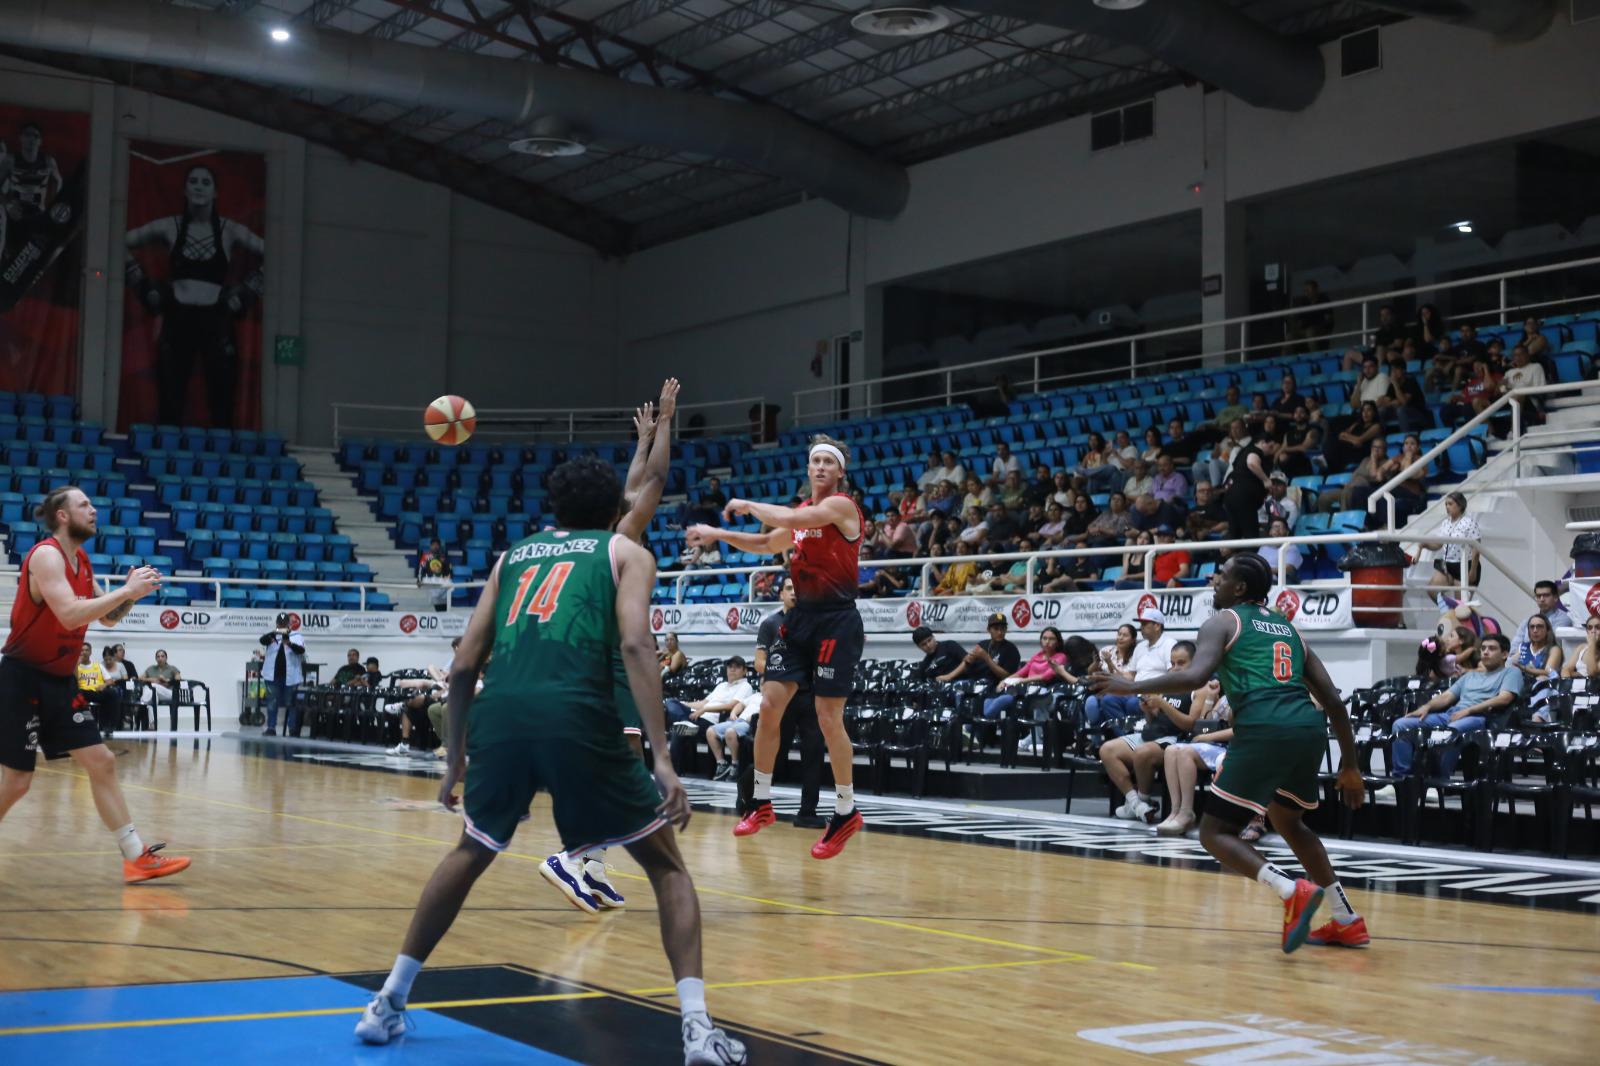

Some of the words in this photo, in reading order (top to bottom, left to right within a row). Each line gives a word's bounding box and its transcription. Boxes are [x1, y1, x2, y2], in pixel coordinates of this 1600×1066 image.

[509, 539, 599, 565] MARTINEZ
[505, 561, 576, 627] 14
[922, 603, 948, 622] UAD
[1031, 600, 1062, 620] CID
[1160, 594, 1193, 616] UAD
[1302, 593, 1340, 616] CID
[180, 611, 211, 626] CID
[302, 614, 330, 627] UAD
[419, 616, 438, 629] CID
[664, 609, 682, 625] CID
[740, 609, 762, 625] UAD
[1100, 611, 1122, 620] LOBOS
[1252, 619, 1292, 637] EVANS
[817, 639, 837, 664] 11
[1273, 641, 1293, 683] 6
